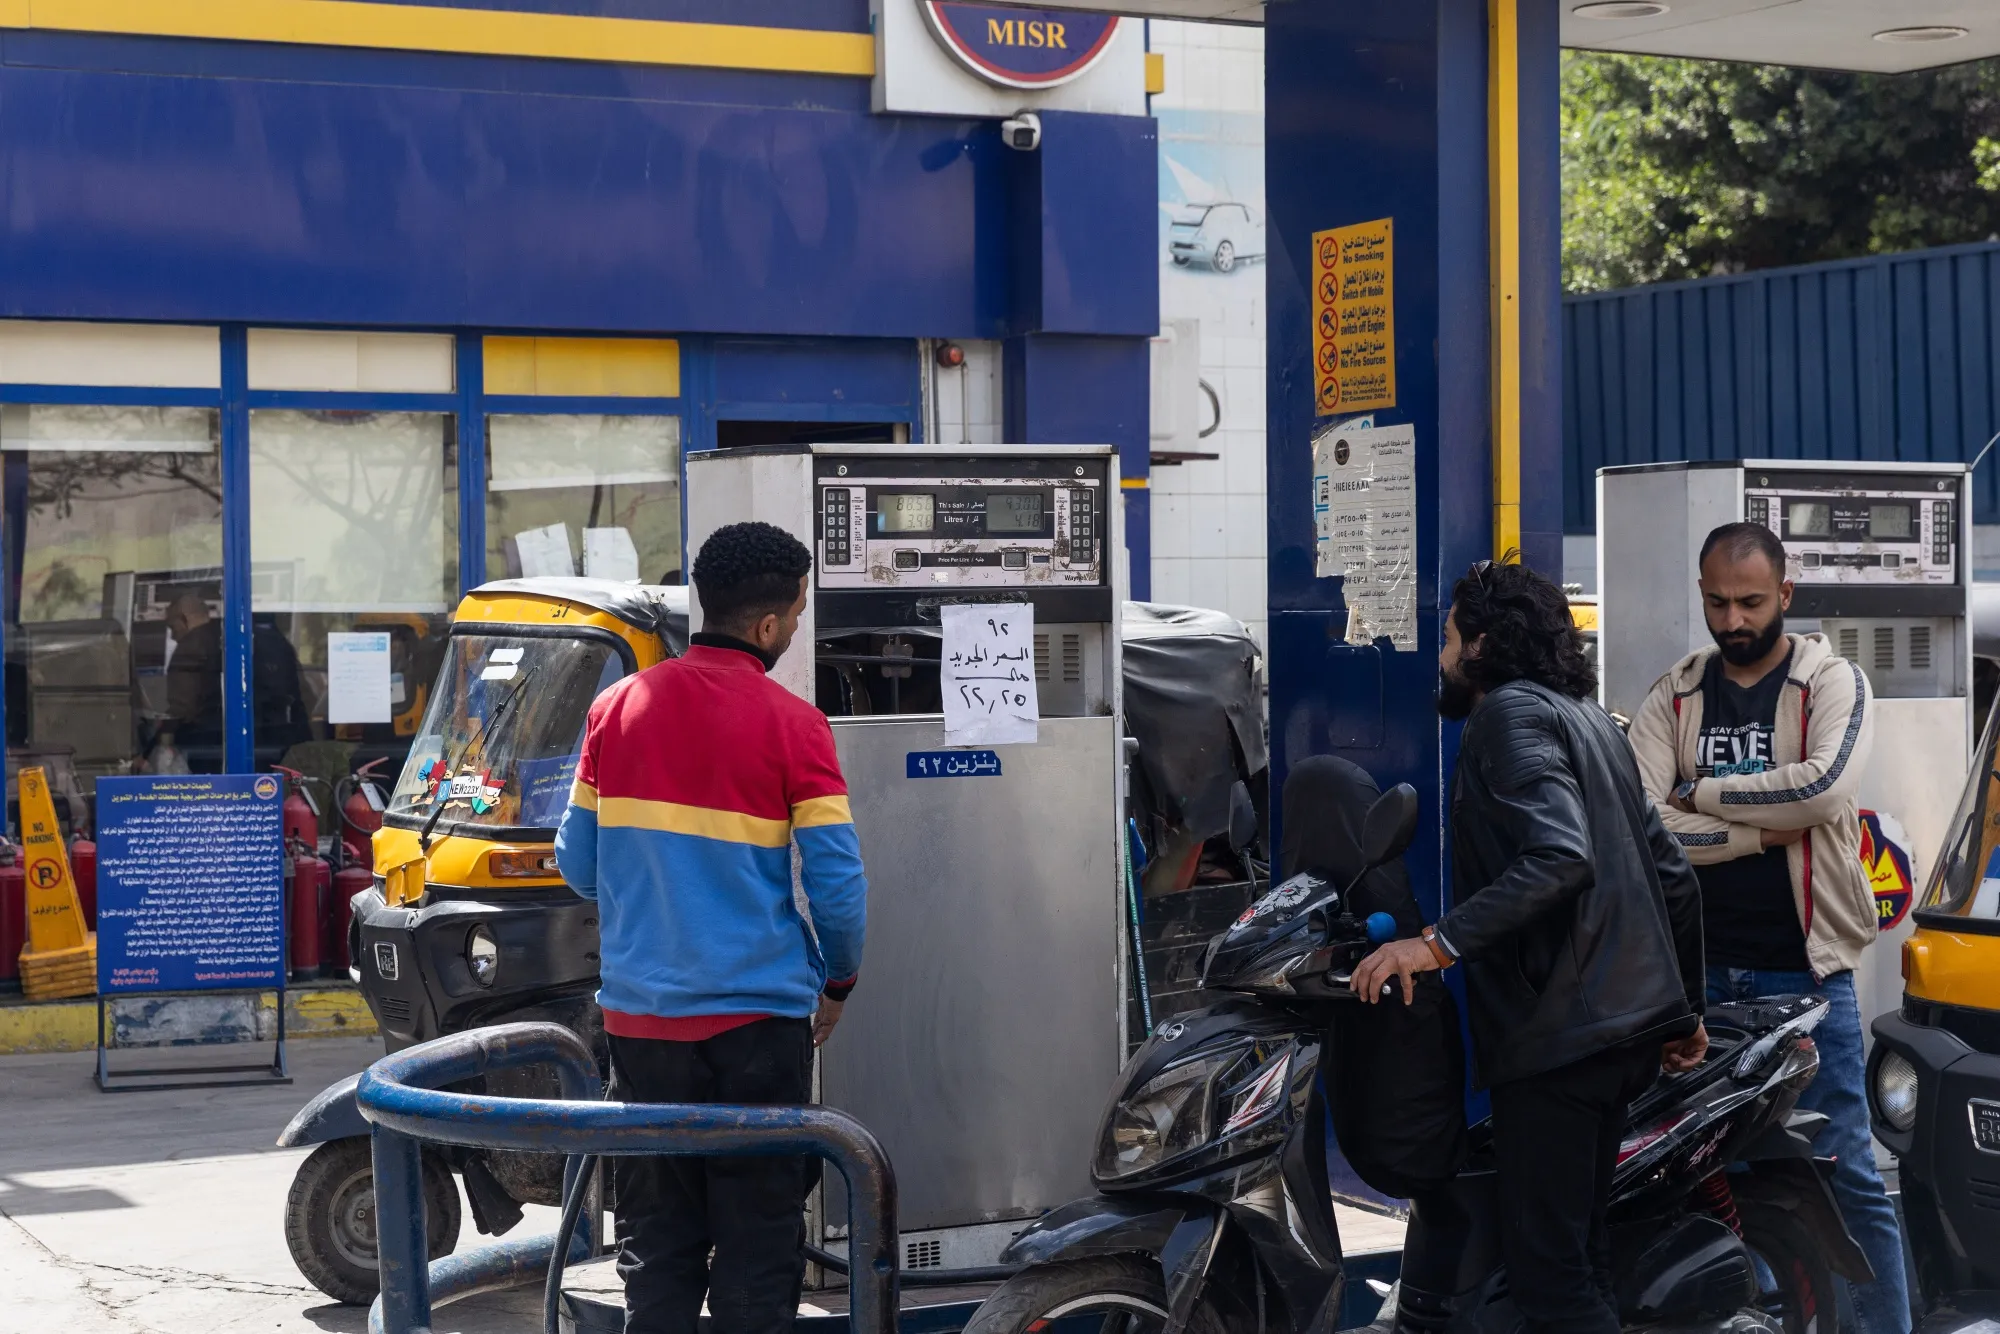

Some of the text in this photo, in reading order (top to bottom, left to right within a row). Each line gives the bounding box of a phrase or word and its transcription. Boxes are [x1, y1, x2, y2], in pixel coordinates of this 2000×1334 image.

[986, 19, 1067, 48] MISR
[1342, 235, 1384, 253] ممنوع التدخين
[1343, 251, 1384, 264] No Smoking
[1342, 288, 1358, 300] Switch
[1368, 284, 1384, 296] Mobile
[1341, 322, 1357, 335] switch
[1367, 319, 1385, 335] Engine
[1341, 355, 1386, 368] No Fire Sources
[1359, 386, 1386, 394] monitored
[1341, 396, 1348, 404] By
[1349, 394, 1372, 402] Cameras
[1015, 513, 1040, 527] 4.18
[988, 619, 1009, 636] ٩٢
[949, 643, 1029, 668] السعر الجديد
[1710, 727, 1732, 735] STAY
[918, 754, 997, 775] بنزين ٩٢
[1742, 761, 1761, 773] UP
[33, 822, 44, 832] NO
[26, 833, 56, 845] PARKING
[1875, 899, 1895, 918] SR
